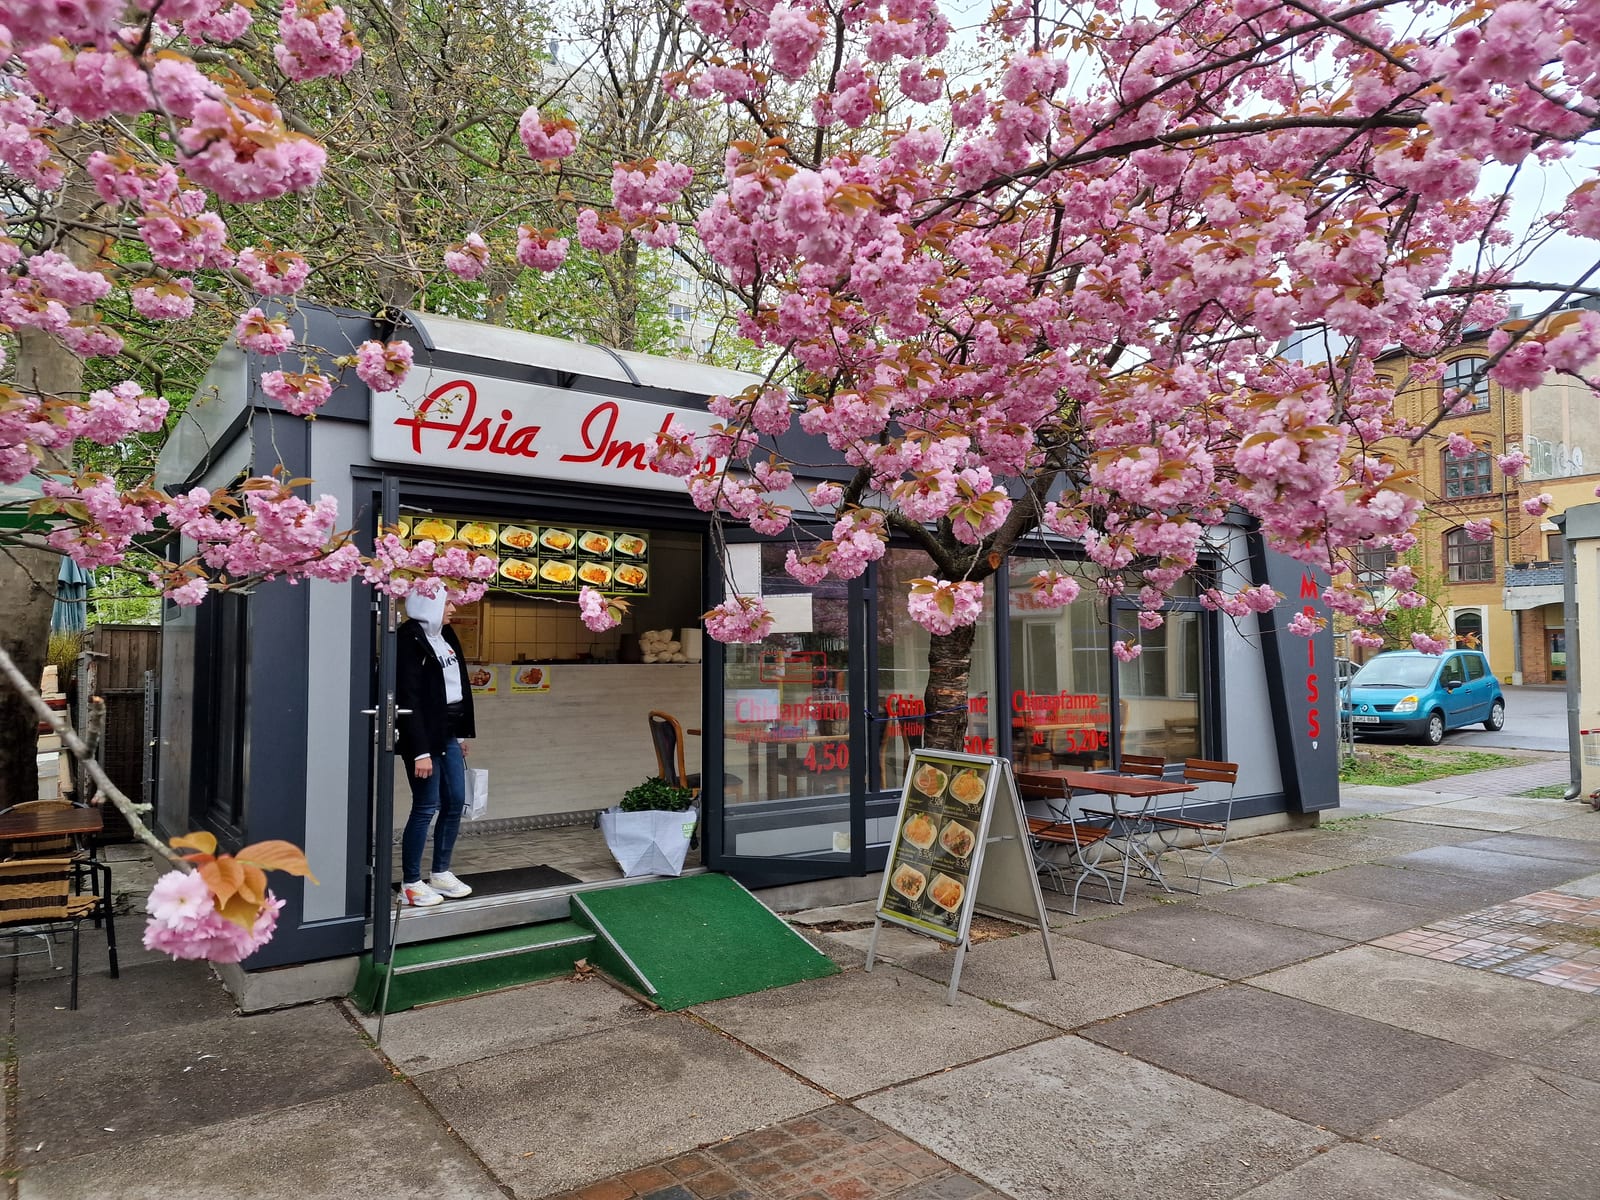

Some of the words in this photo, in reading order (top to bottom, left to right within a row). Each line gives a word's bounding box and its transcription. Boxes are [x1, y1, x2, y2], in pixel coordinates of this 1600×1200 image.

[394, 379, 541, 458] Asia
[560, 401, 716, 476] Ims
[736, 696, 850, 726] Chinapfann
[1012, 690, 1100, 716] Chinapfanne
[804, 743, 850, 774] 4,50
